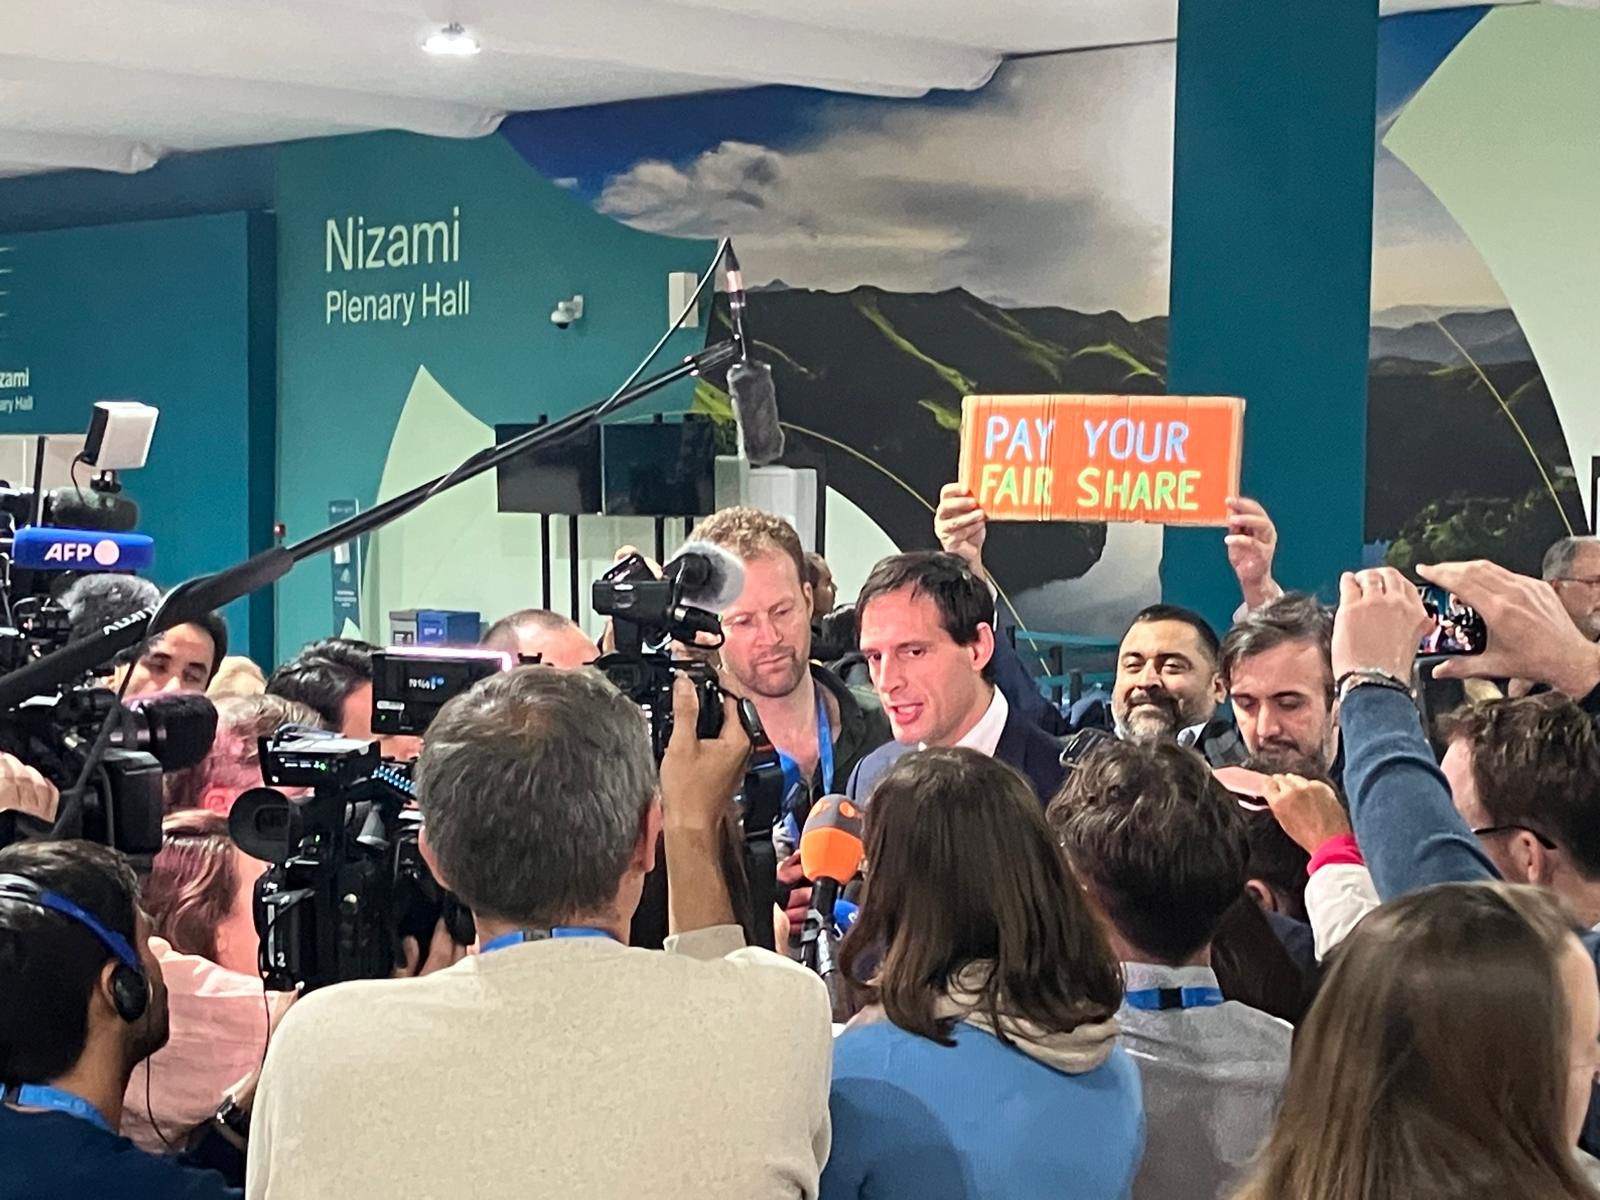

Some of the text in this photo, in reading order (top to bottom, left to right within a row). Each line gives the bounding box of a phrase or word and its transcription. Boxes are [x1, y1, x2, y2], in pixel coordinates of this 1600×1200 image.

[326, 206, 459, 272] Nizami
[326, 280, 469, 327] Plenary Hall
[985, 416, 1189, 463] PAY YOUR
[979, 463, 1201, 511] FAIR SHARE
[44, 543, 92, 561] AFP
